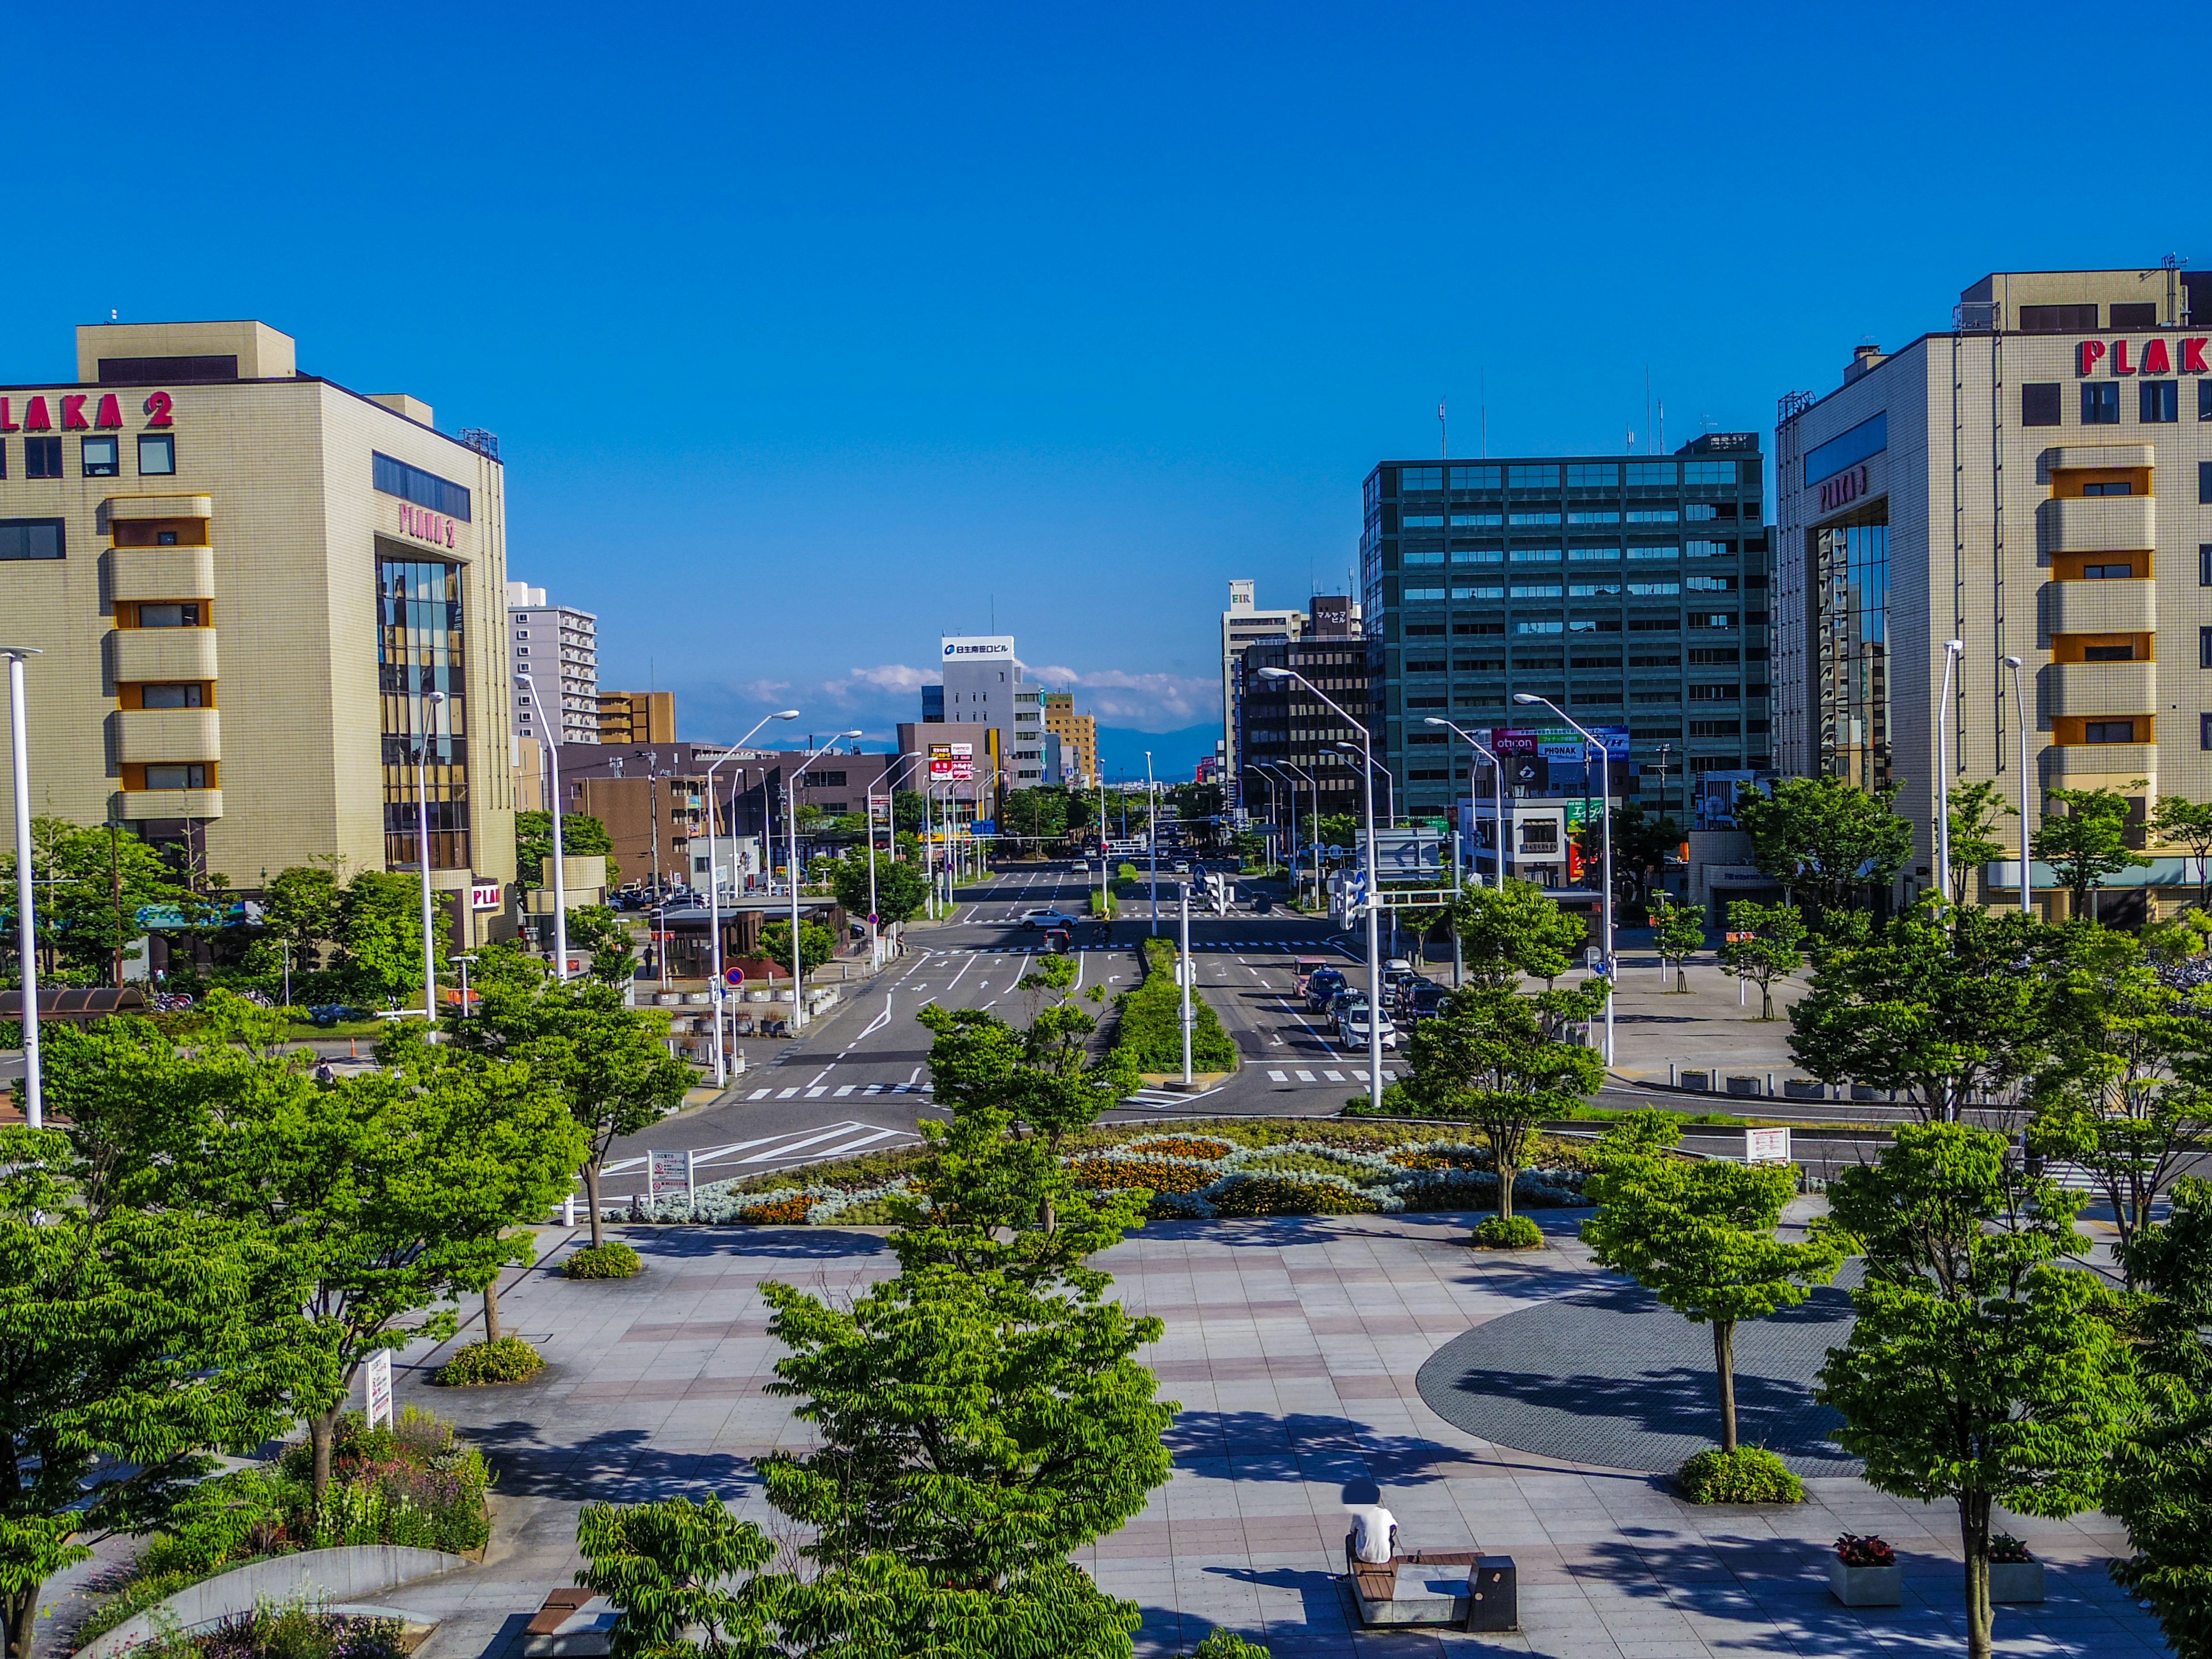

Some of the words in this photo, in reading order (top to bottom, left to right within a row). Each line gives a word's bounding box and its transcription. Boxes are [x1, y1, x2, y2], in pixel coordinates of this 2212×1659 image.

[2082, 338, 2210, 374] PLAK
[0, 393, 123, 429] LAKA
[148, 391, 173, 425] 2
[399, 503, 442, 545] PLAKA
[446, 520, 455, 549] 2
[1232, 594, 1251, 603] EIR
[1497, 738, 1532, 748] oticon
